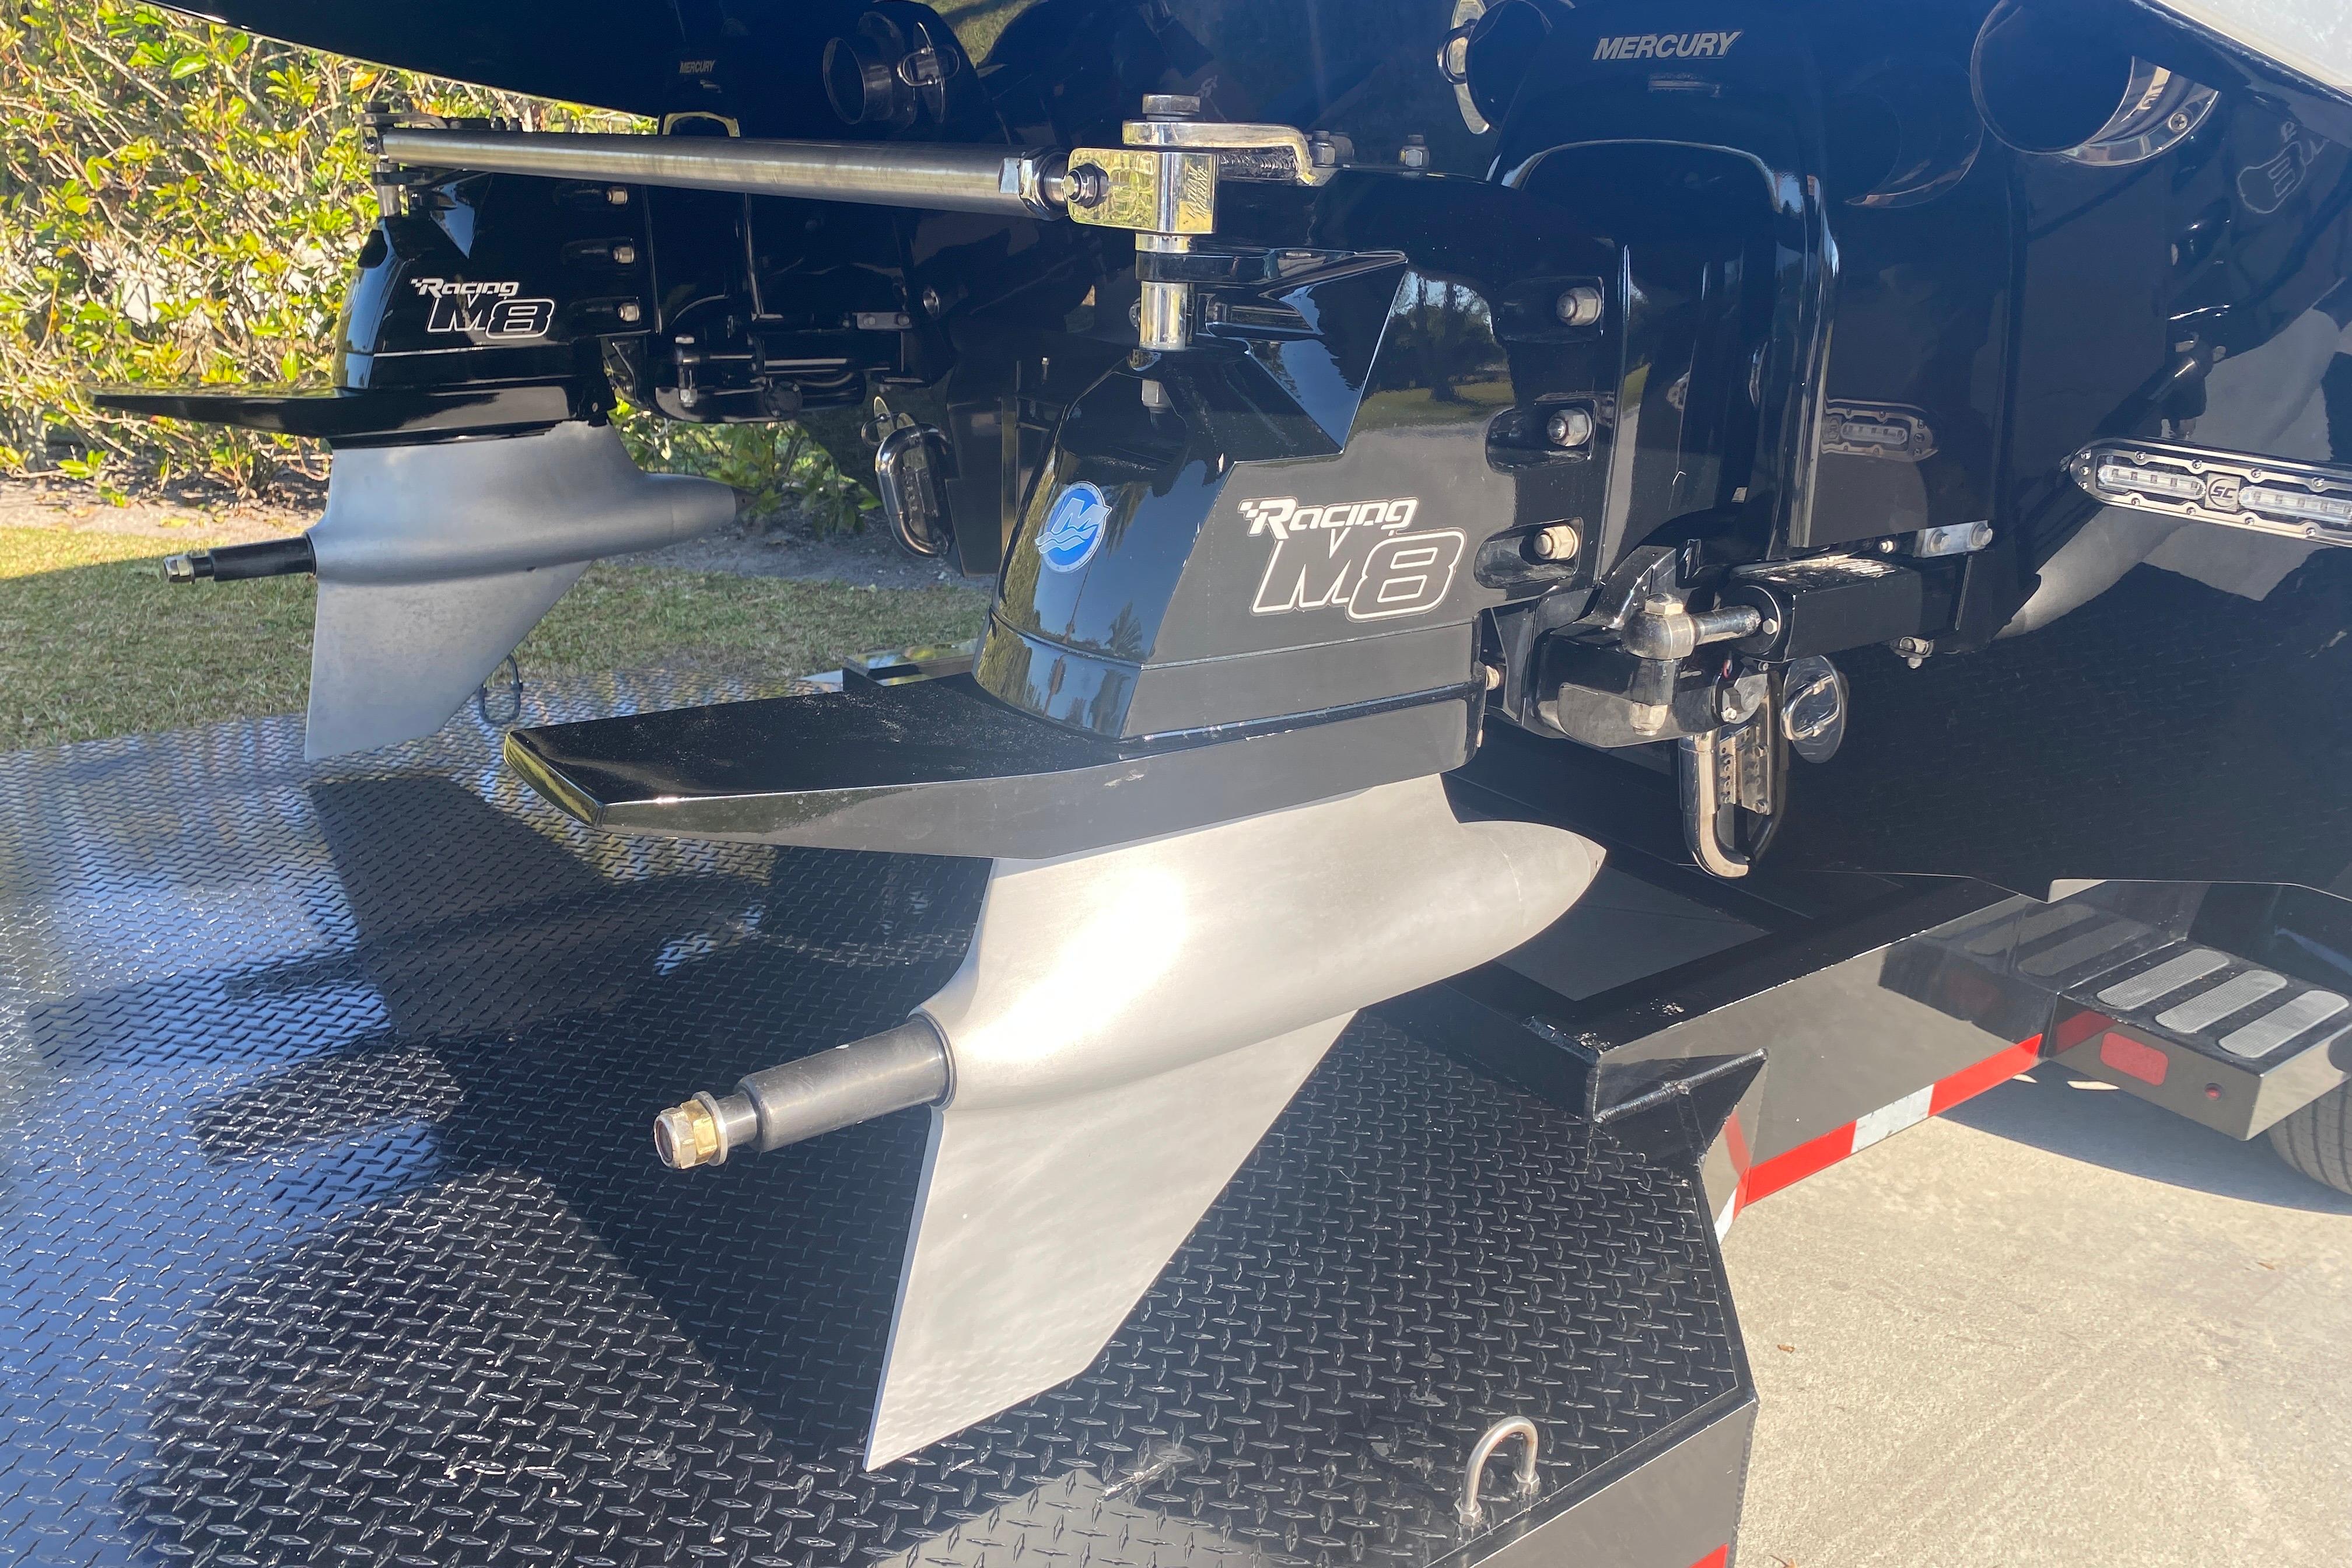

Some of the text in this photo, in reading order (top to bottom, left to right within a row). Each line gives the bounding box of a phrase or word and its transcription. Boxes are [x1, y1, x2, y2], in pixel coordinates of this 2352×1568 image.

[1592, 31, 1741, 60] MERCURY
[679, 60, 715, 74] MERCURY
[411, 278, 519, 298] Racing
[427, 296, 555, 340] M8
[2211, 486, 2237, 498] SC
[1239, 498, 1419, 540] Racing
[1252, 527, 1466, 620] M8
